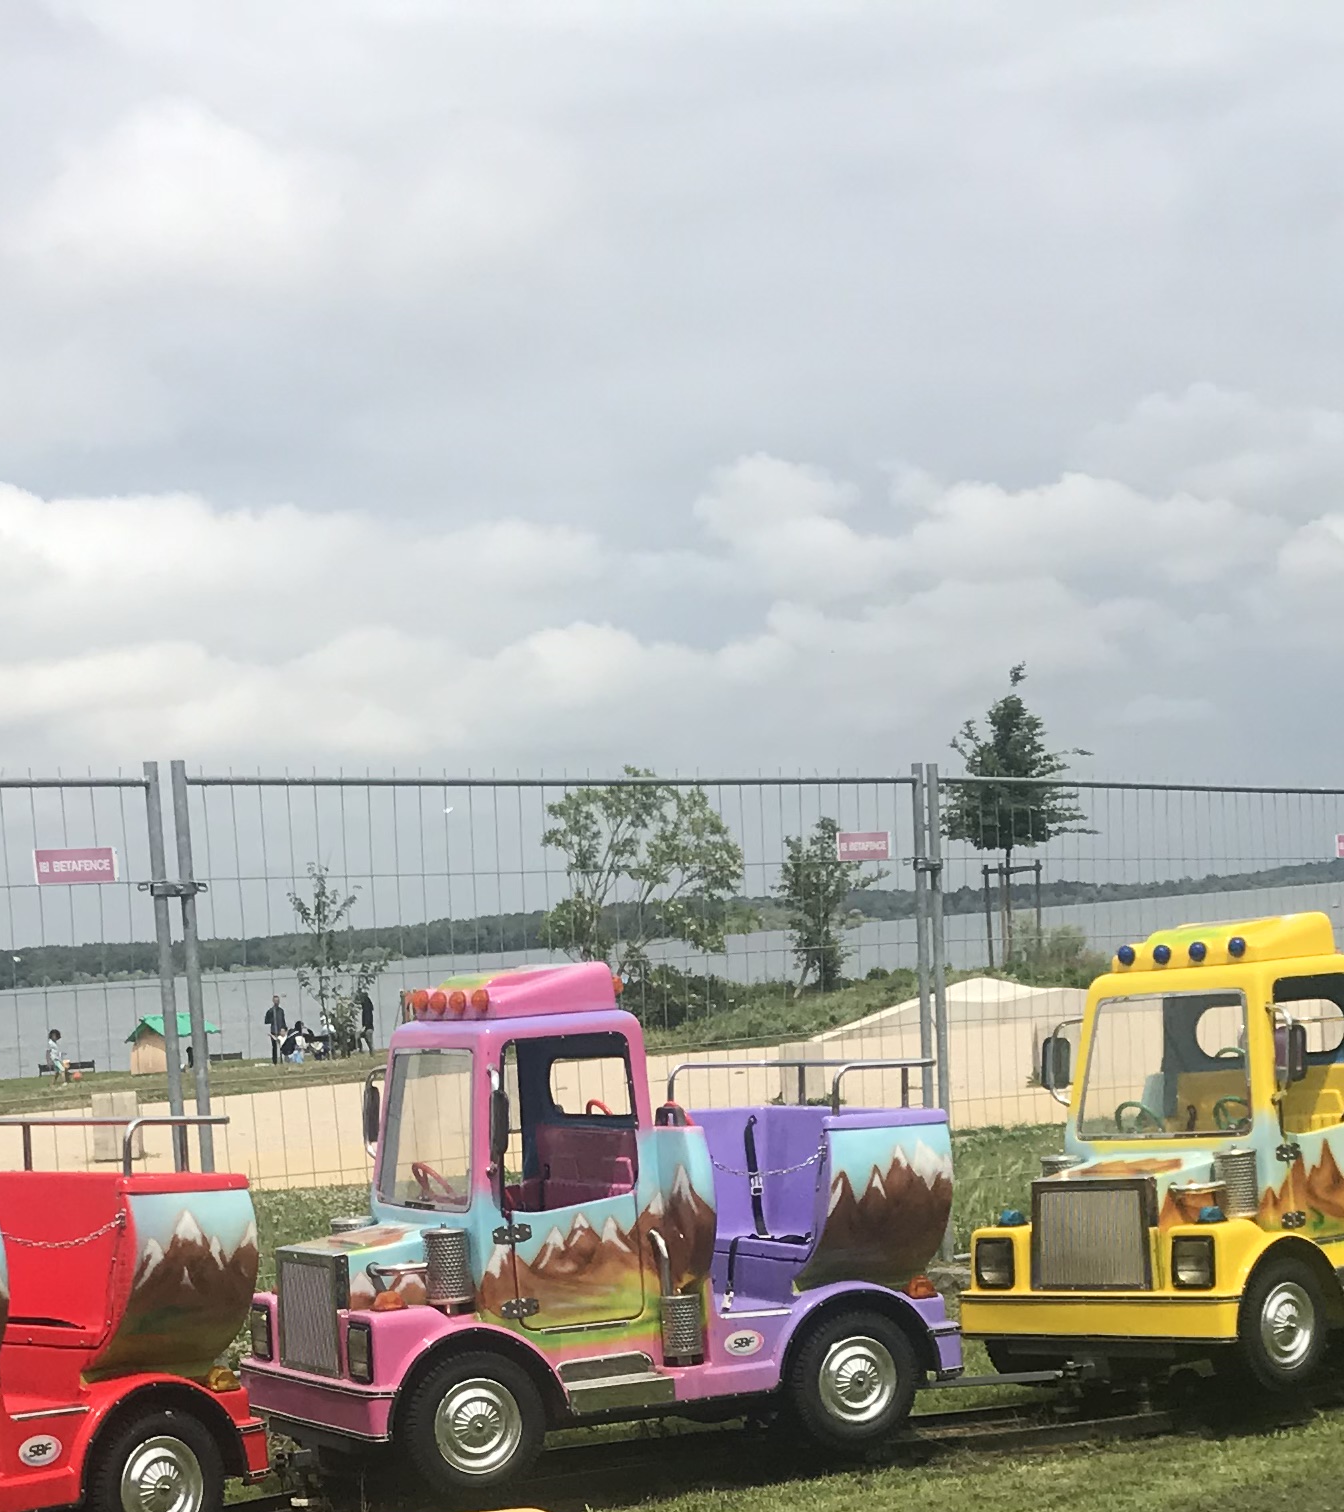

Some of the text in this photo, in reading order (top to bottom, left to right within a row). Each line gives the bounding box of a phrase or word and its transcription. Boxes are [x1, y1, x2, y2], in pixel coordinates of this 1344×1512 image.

[53, 859, 111, 872] BETAFENCE
[733, 1336, 755, 1348] SBF
[28, 1442, 52, 1457] SBF
